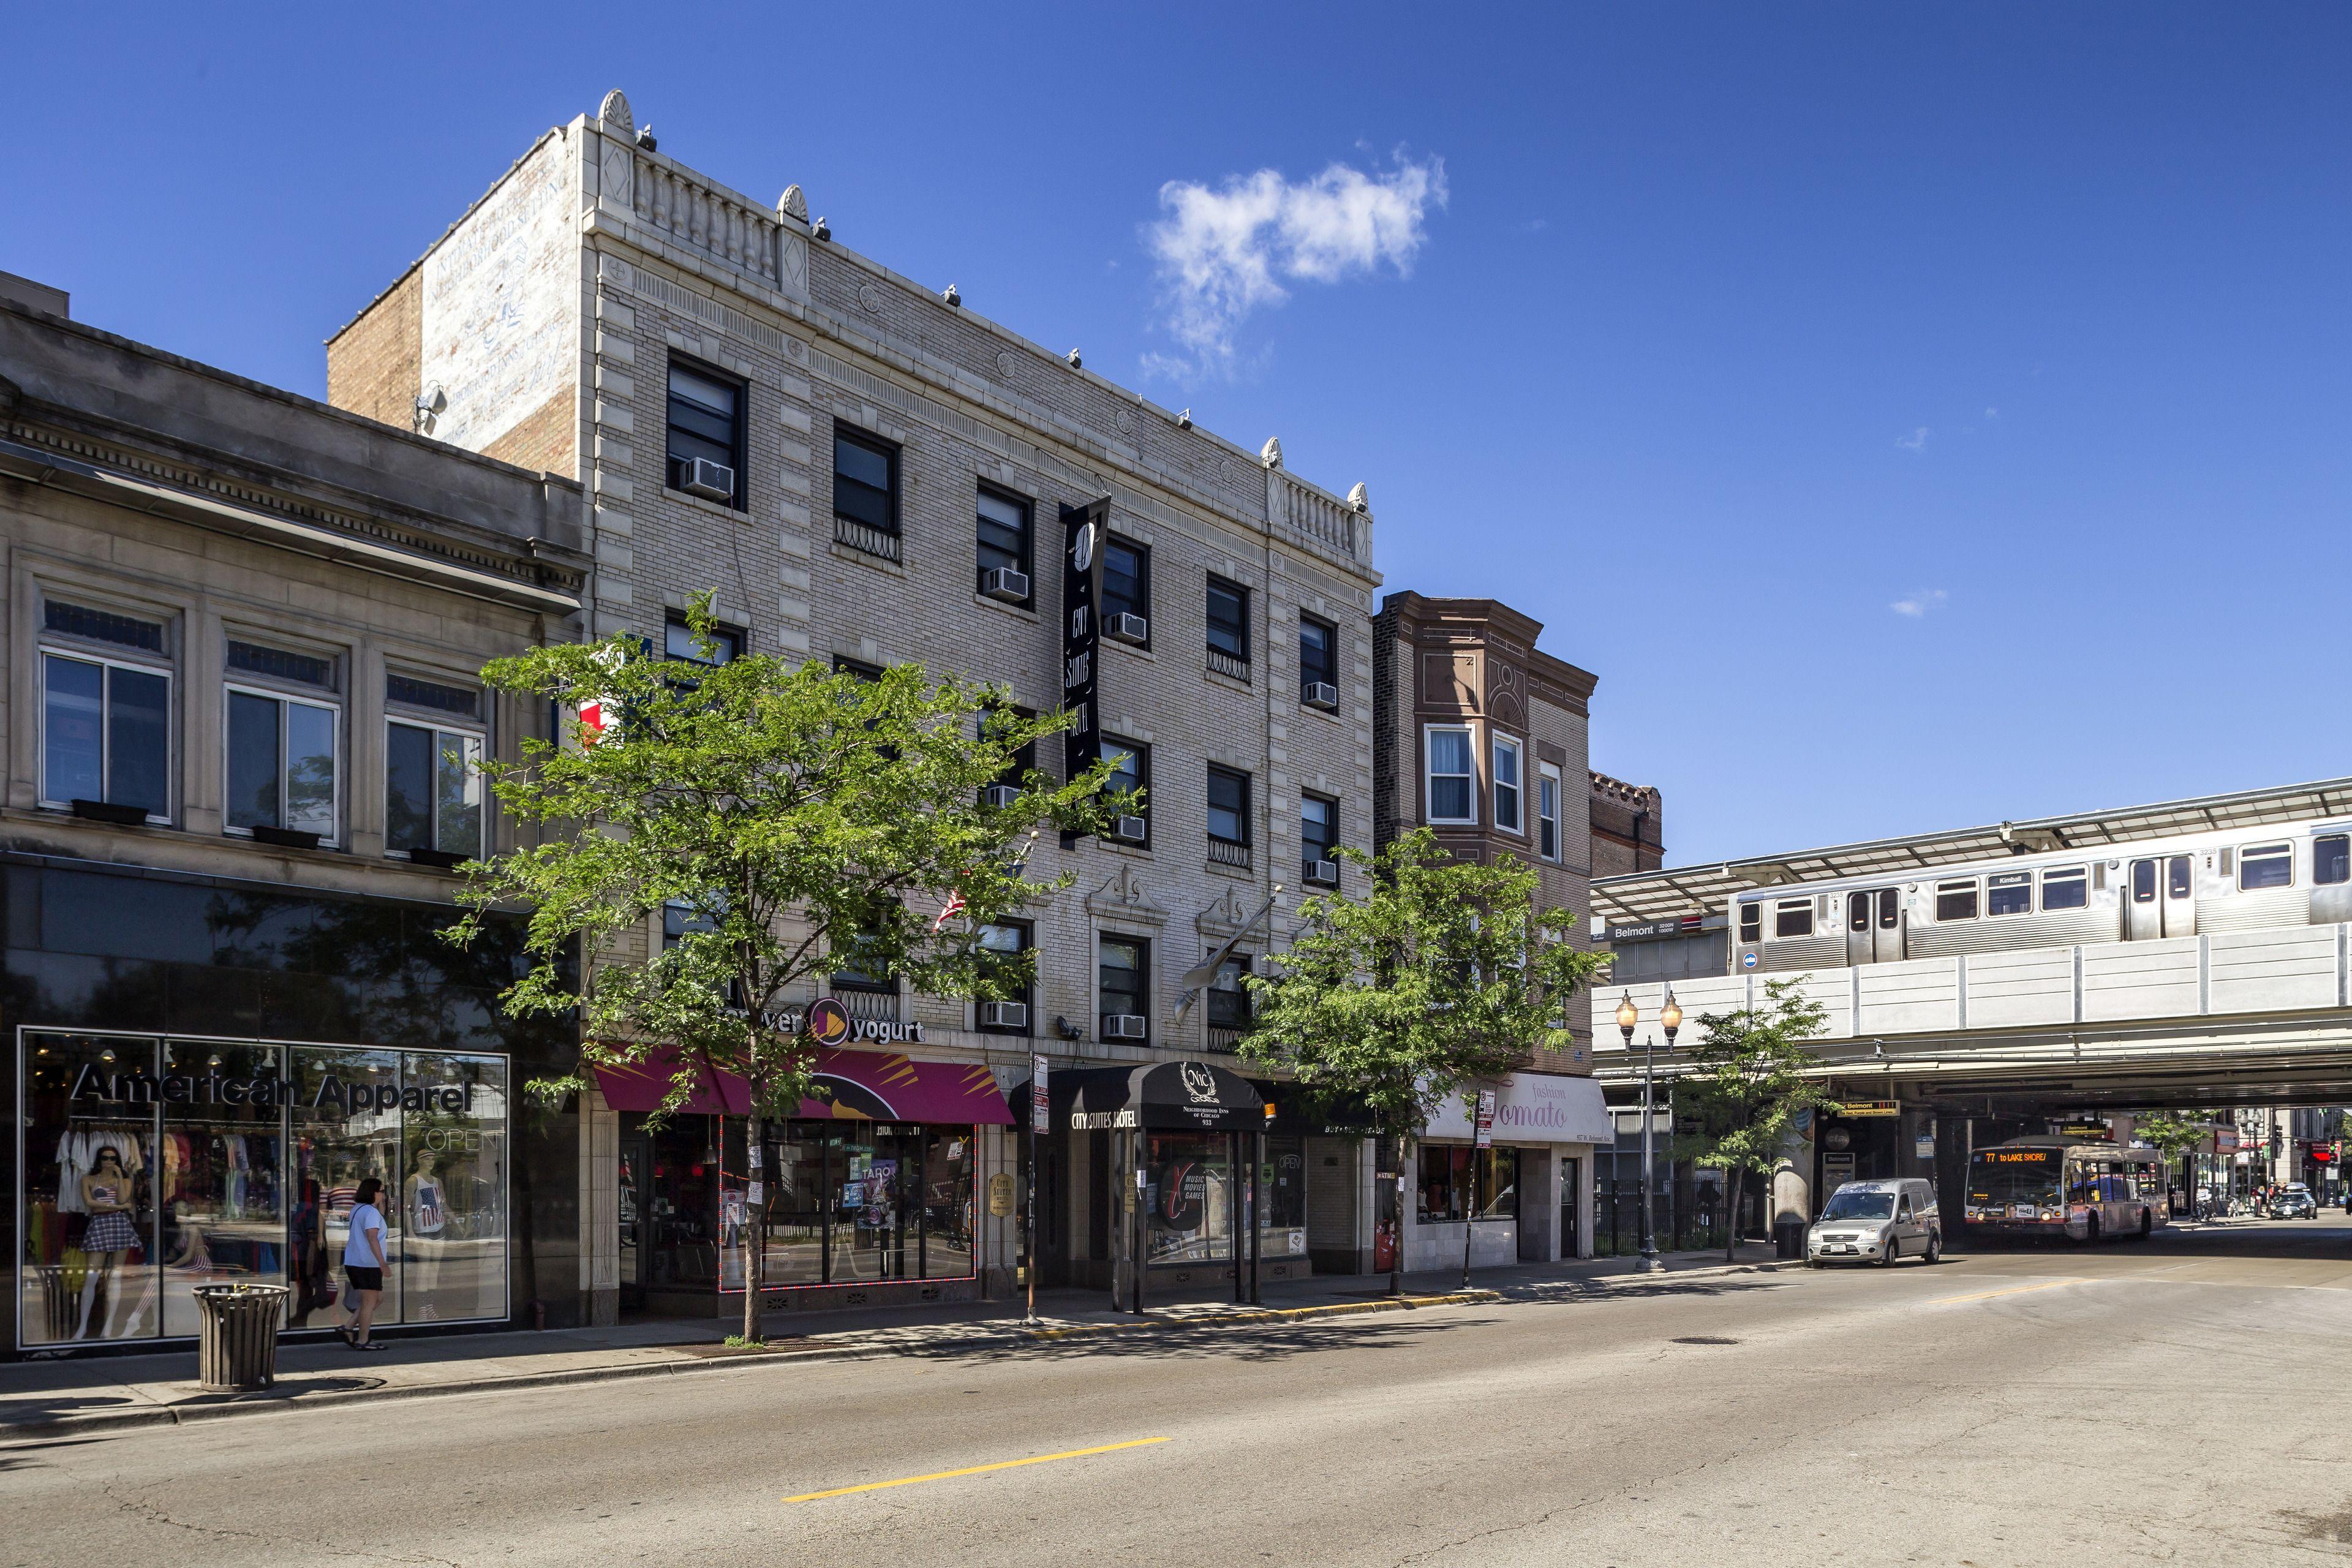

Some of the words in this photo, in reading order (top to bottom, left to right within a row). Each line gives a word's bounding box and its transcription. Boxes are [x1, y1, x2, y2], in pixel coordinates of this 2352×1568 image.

[1073, 605, 1088, 638] CITY
[1066, 650, 1089, 688] SUITES
[1615, 925, 1653, 938] Belmont
[853, 1019, 925, 1044] yogurt
[1188, 1069, 1210, 1087] NIC
[69, 1063, 301, 1107] American
[313, 1074, 472, 1117] Apparel
[1532, 1082, 1566, 1102] fashion
[1071, 1113, 1087, 1129] CITY
[1088, 1112, 1112, 1129] SUITES
[427, 1128, 499, 1151] OPEN
[1279, 1157, 1300, 1169] OPEN
[1986, 1153, 1996, 1163] 77
[993, 1187, 1011, 1196] SUITES
[997, 1178, 1009, 1187] CITY
